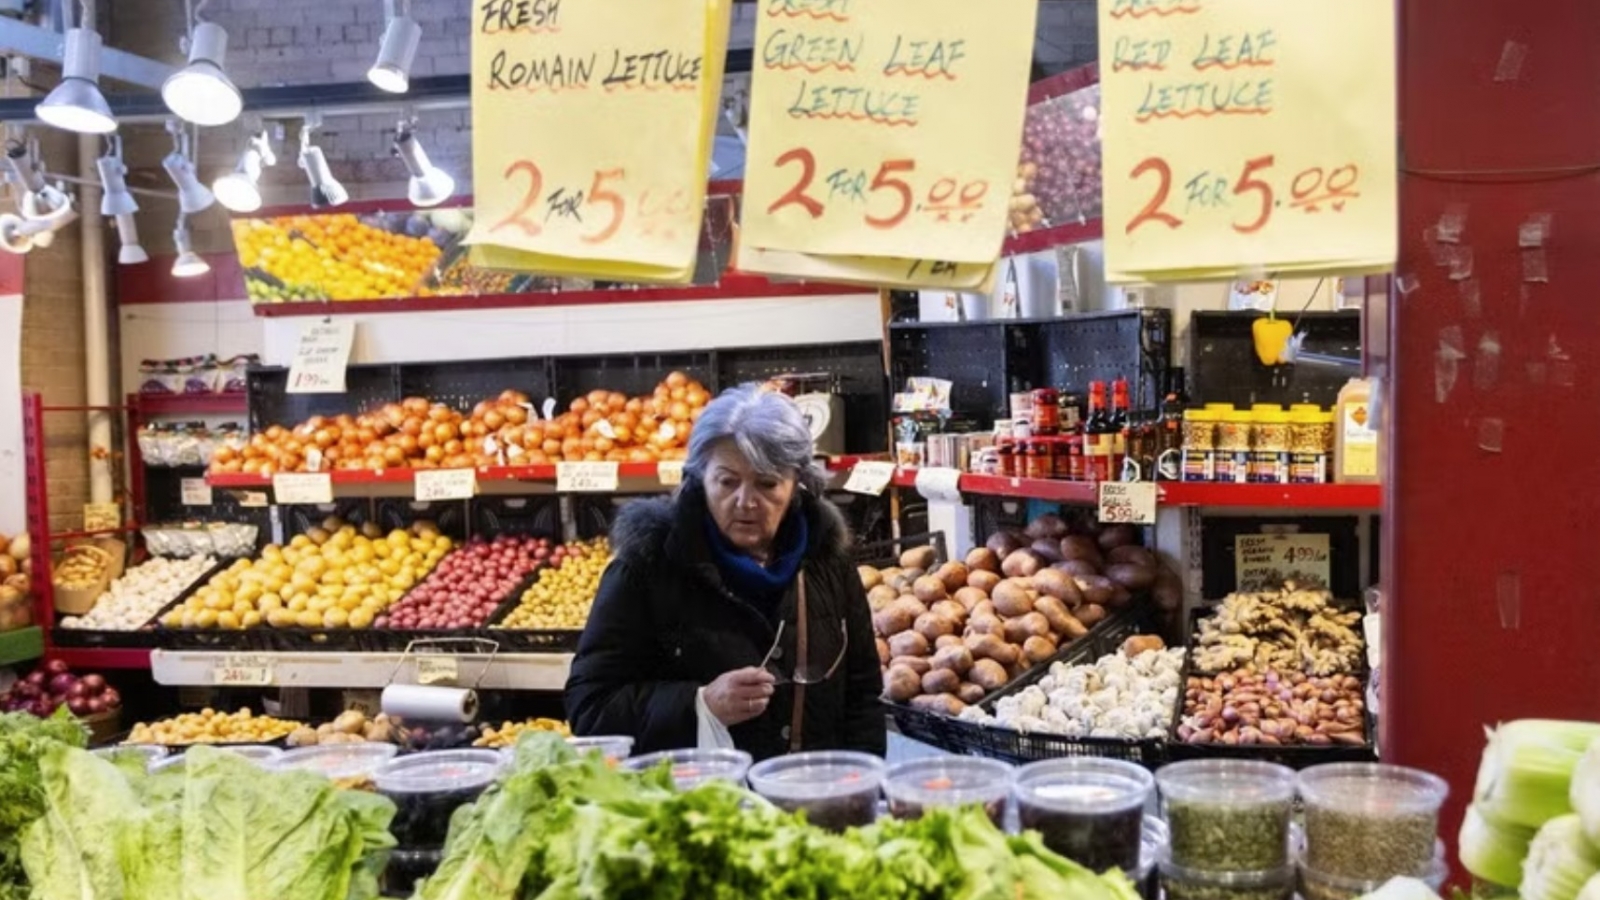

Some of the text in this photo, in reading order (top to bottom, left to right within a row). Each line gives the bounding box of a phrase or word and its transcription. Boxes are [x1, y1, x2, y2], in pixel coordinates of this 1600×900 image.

[481, 0, 559, 32] FRESH
[490, 50, 702, 89] ROMAIN LETTUCE
[763, 29, 965, 74] GREEN LEAF
[1113, 31, 1276, 69] RED LEAF
[787, 81, 919, 116] LETTUCE
[1137, 80, 1272, 114] LETTUCE
[489, 159, 543, 236] 2
[545, 187, 584, 223] FOR
[767, 148, 824, 218] 2
[826, 168, 868, 203] FOR
[1126, 157, 1183, 234] 2
[1184, 171, 1229, 213] FOR
